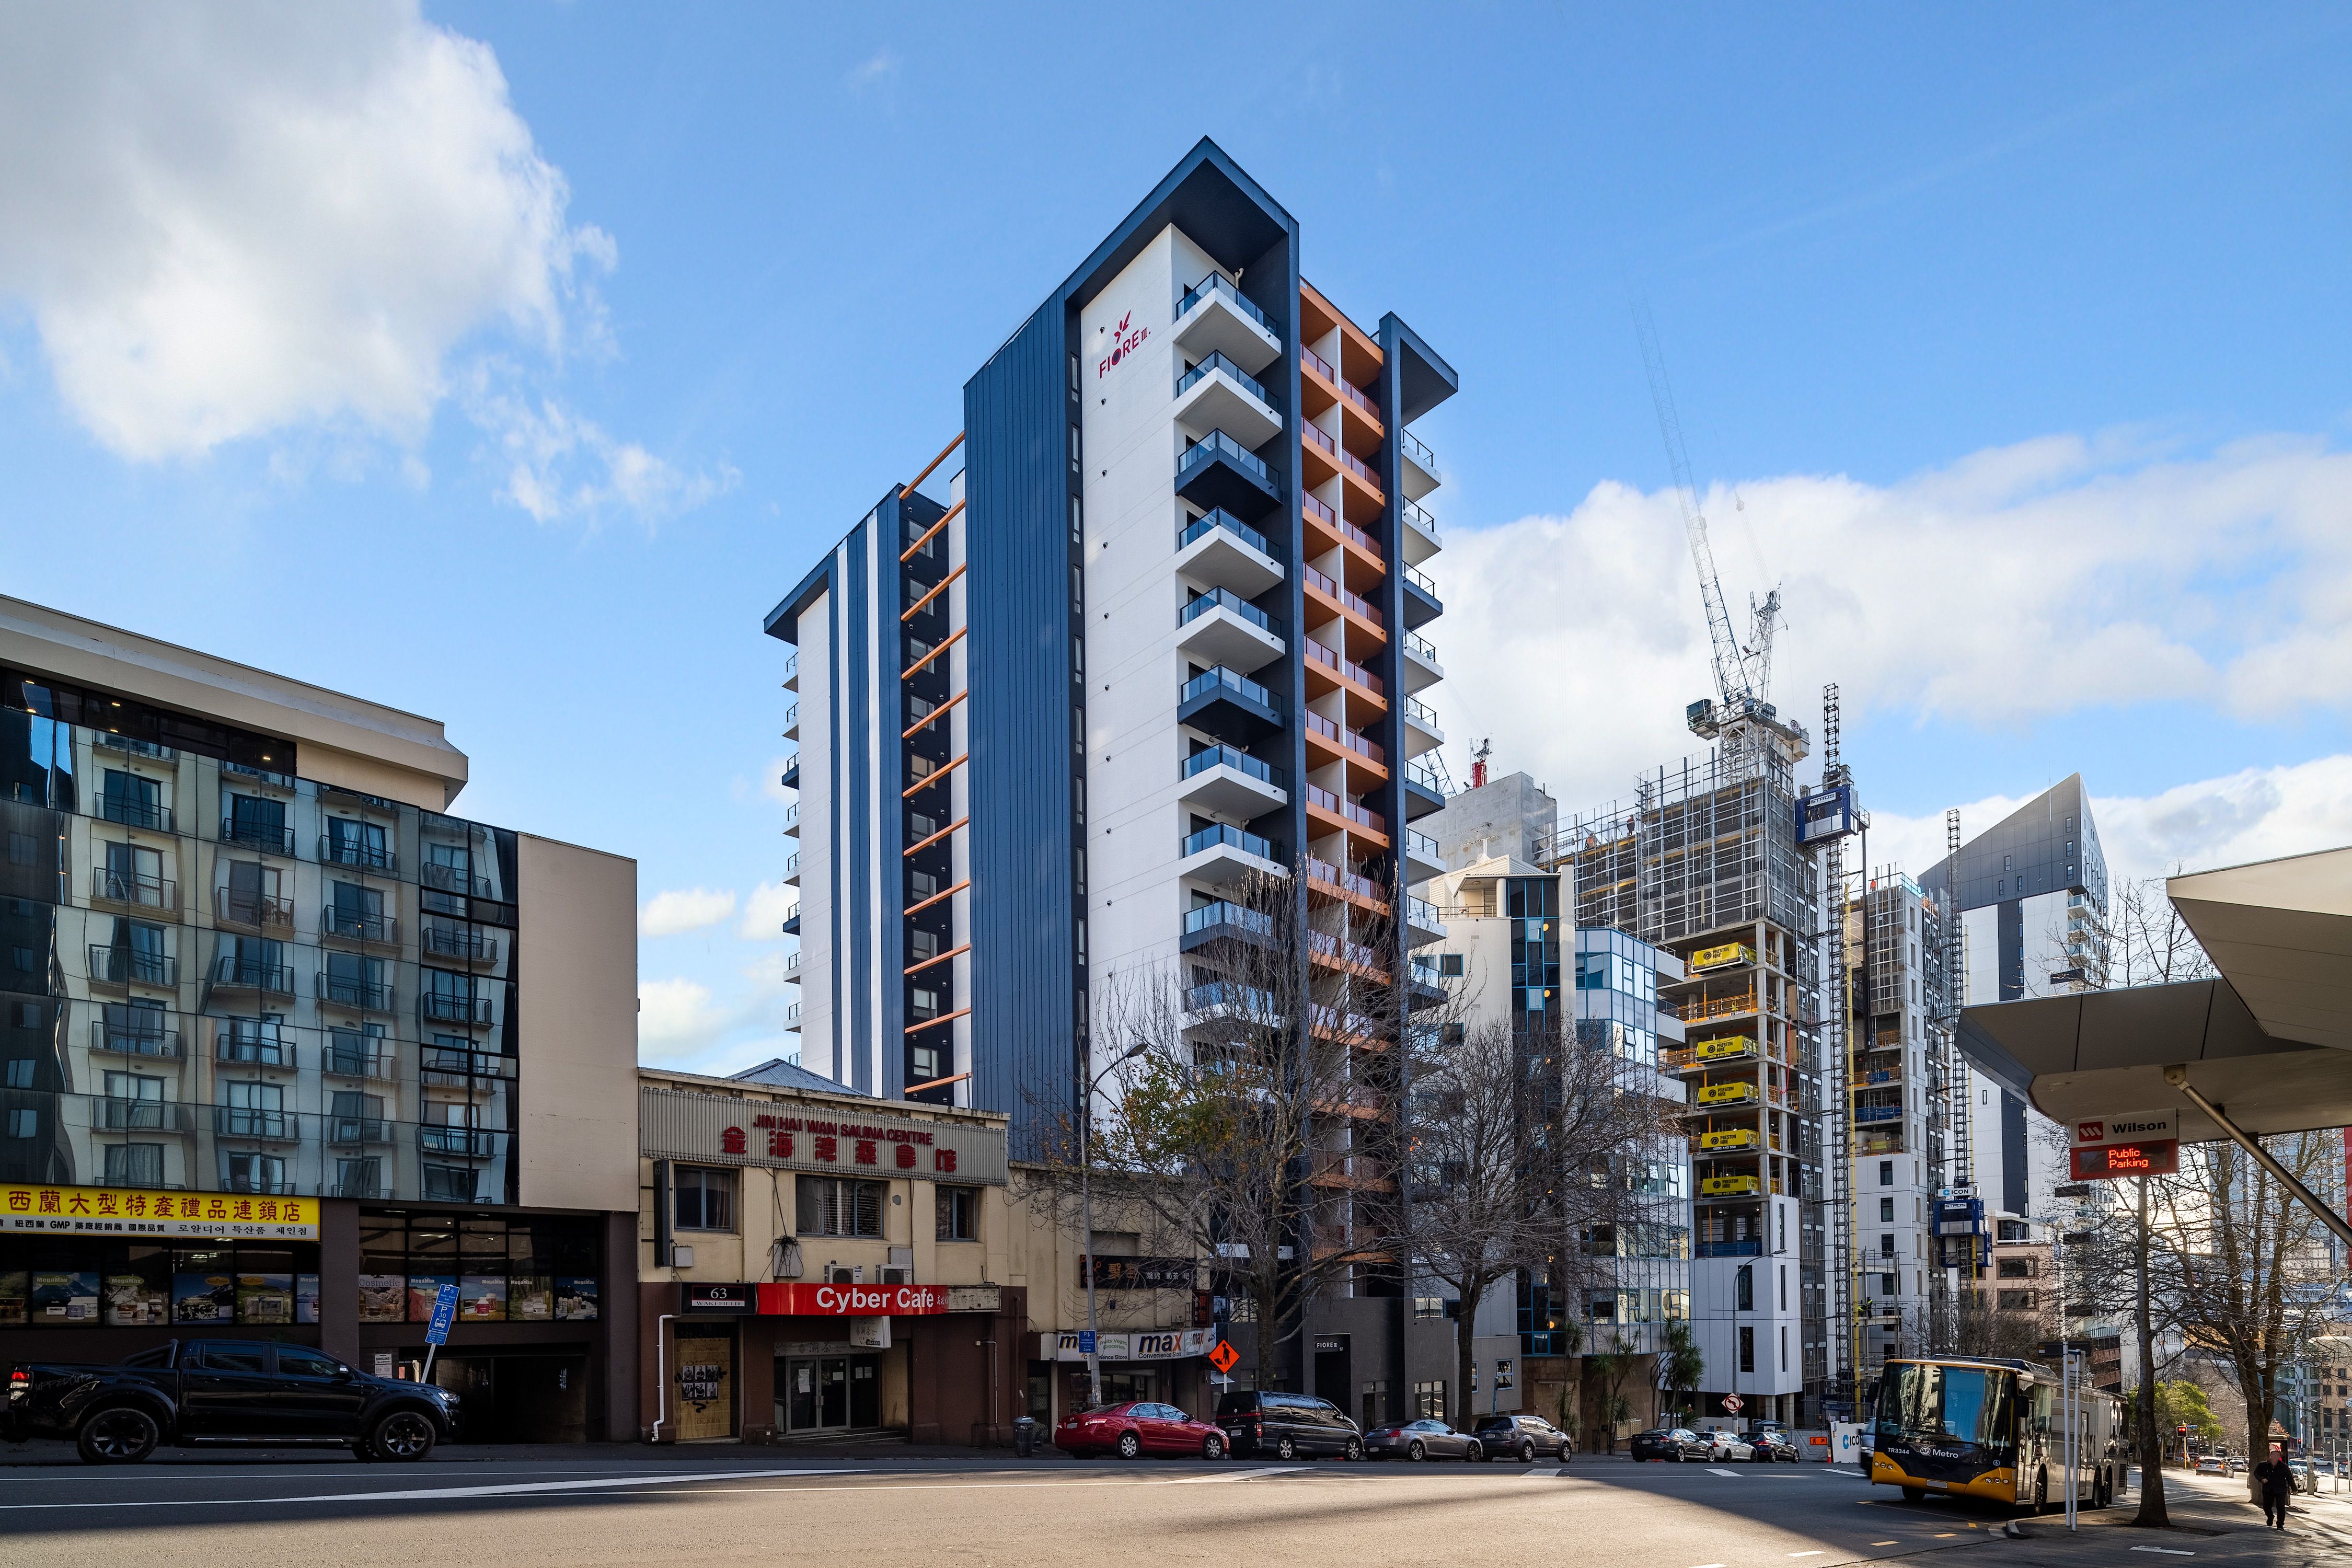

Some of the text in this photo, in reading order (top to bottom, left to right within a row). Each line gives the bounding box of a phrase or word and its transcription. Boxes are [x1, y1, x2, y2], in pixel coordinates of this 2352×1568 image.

[1100, 329, 1139, 379] FIORE
[753, 1114, 933, 1146] JIN HAI WAN SAUNA CENTRE
[2112, 1122, 2166, 1134] Wilson
[2109, 1148, 2140, 1159] Public
[2109, 1158, 2149, 1169] Parking
[50, 1220, 71, 1229] GMP
[232, 1226, 266, 1235] 특산품
[359, 1278, 400, 1287] Cosmetic
[710, 1288, 727, 1299] 63
[816, 1287, 891, 1313] Cyber
[897, 1288, 934, 1308] Cafe
[1139, 1329, 1183, 1353] max
[1192, 1332, 1204, 1350] max
[1933, 1449, 1959, 1458] Metro
